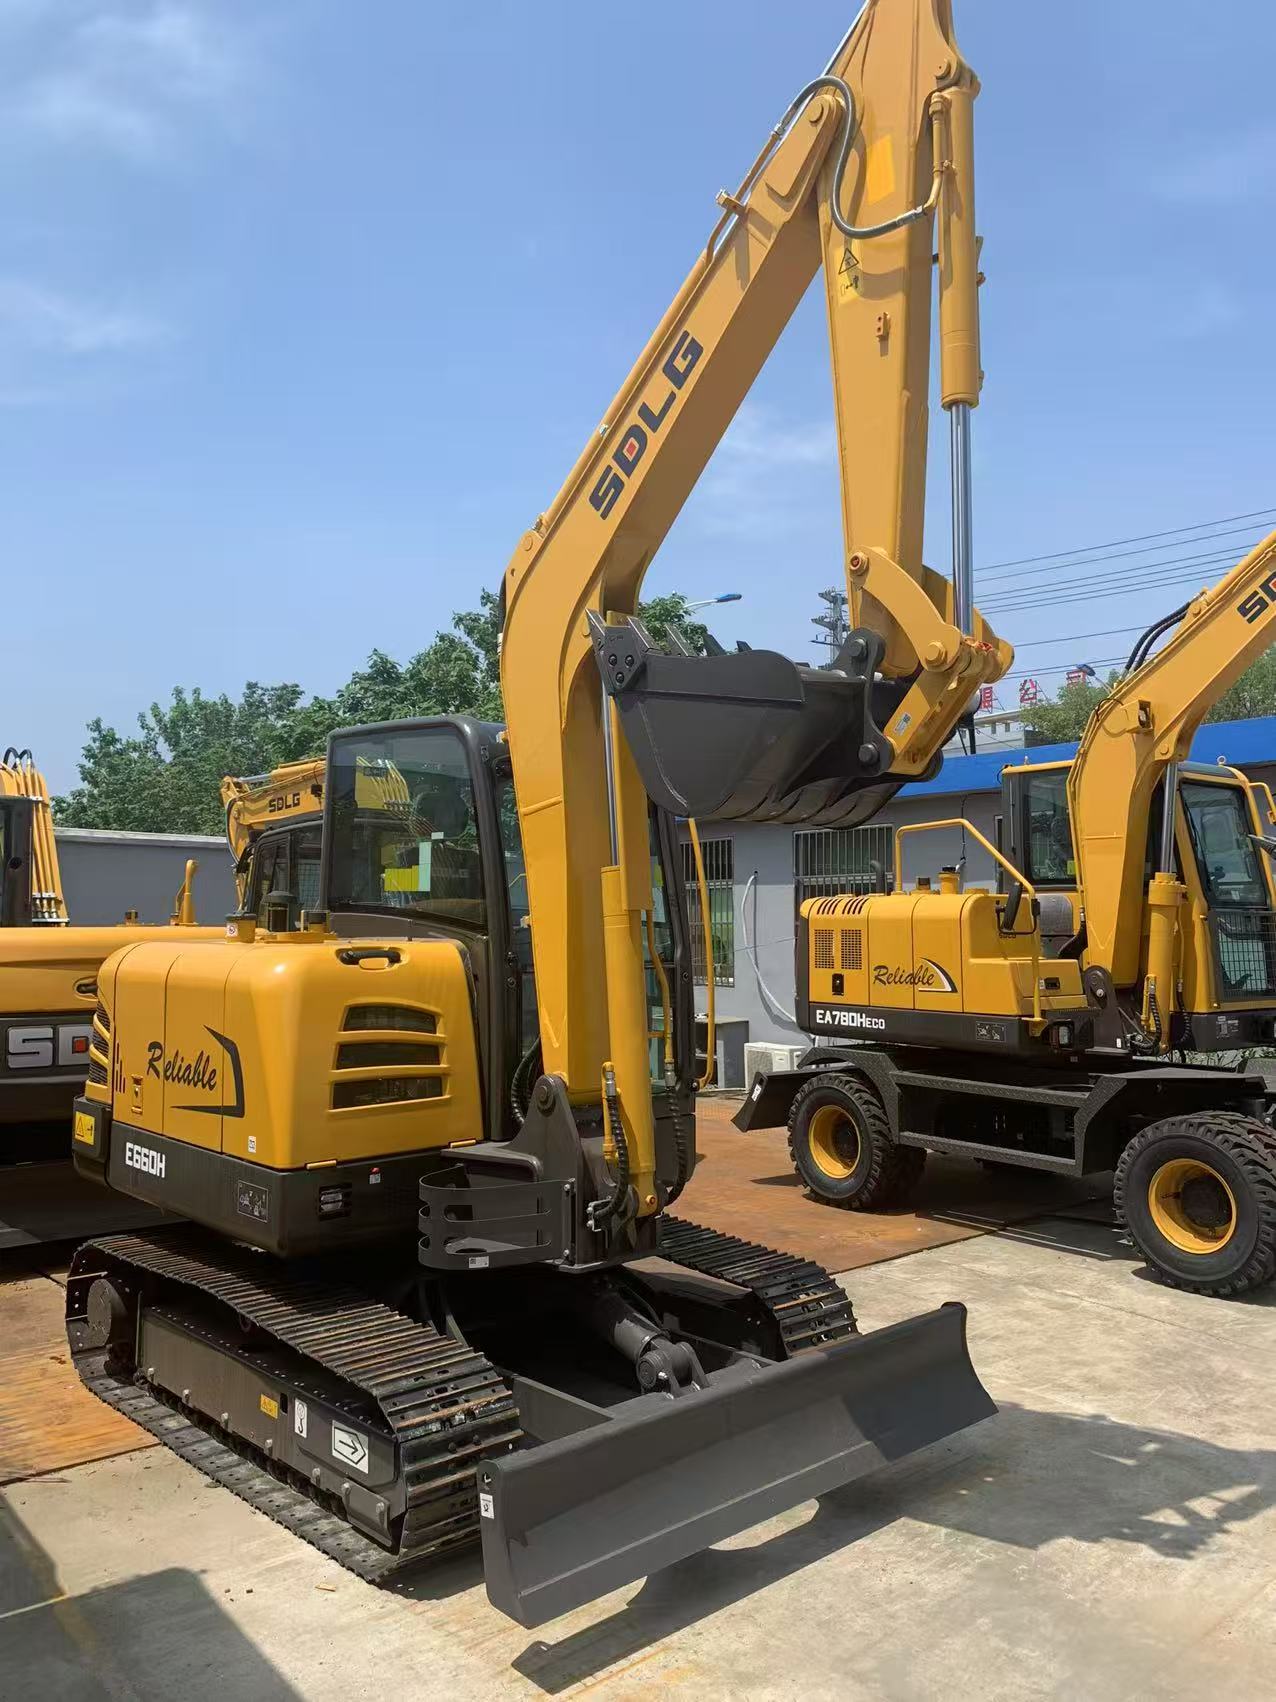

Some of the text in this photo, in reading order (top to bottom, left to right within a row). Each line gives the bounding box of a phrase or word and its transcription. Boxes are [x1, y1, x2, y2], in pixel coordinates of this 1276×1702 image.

[588, 329, 704, 520] SDLG
[268, 791, 301, 813] SDLG
[873, 964, 935, 987] Reliable
[146, 1040, 218, 1091] Reliable
[125, 1141, 166, 1179] E660H
